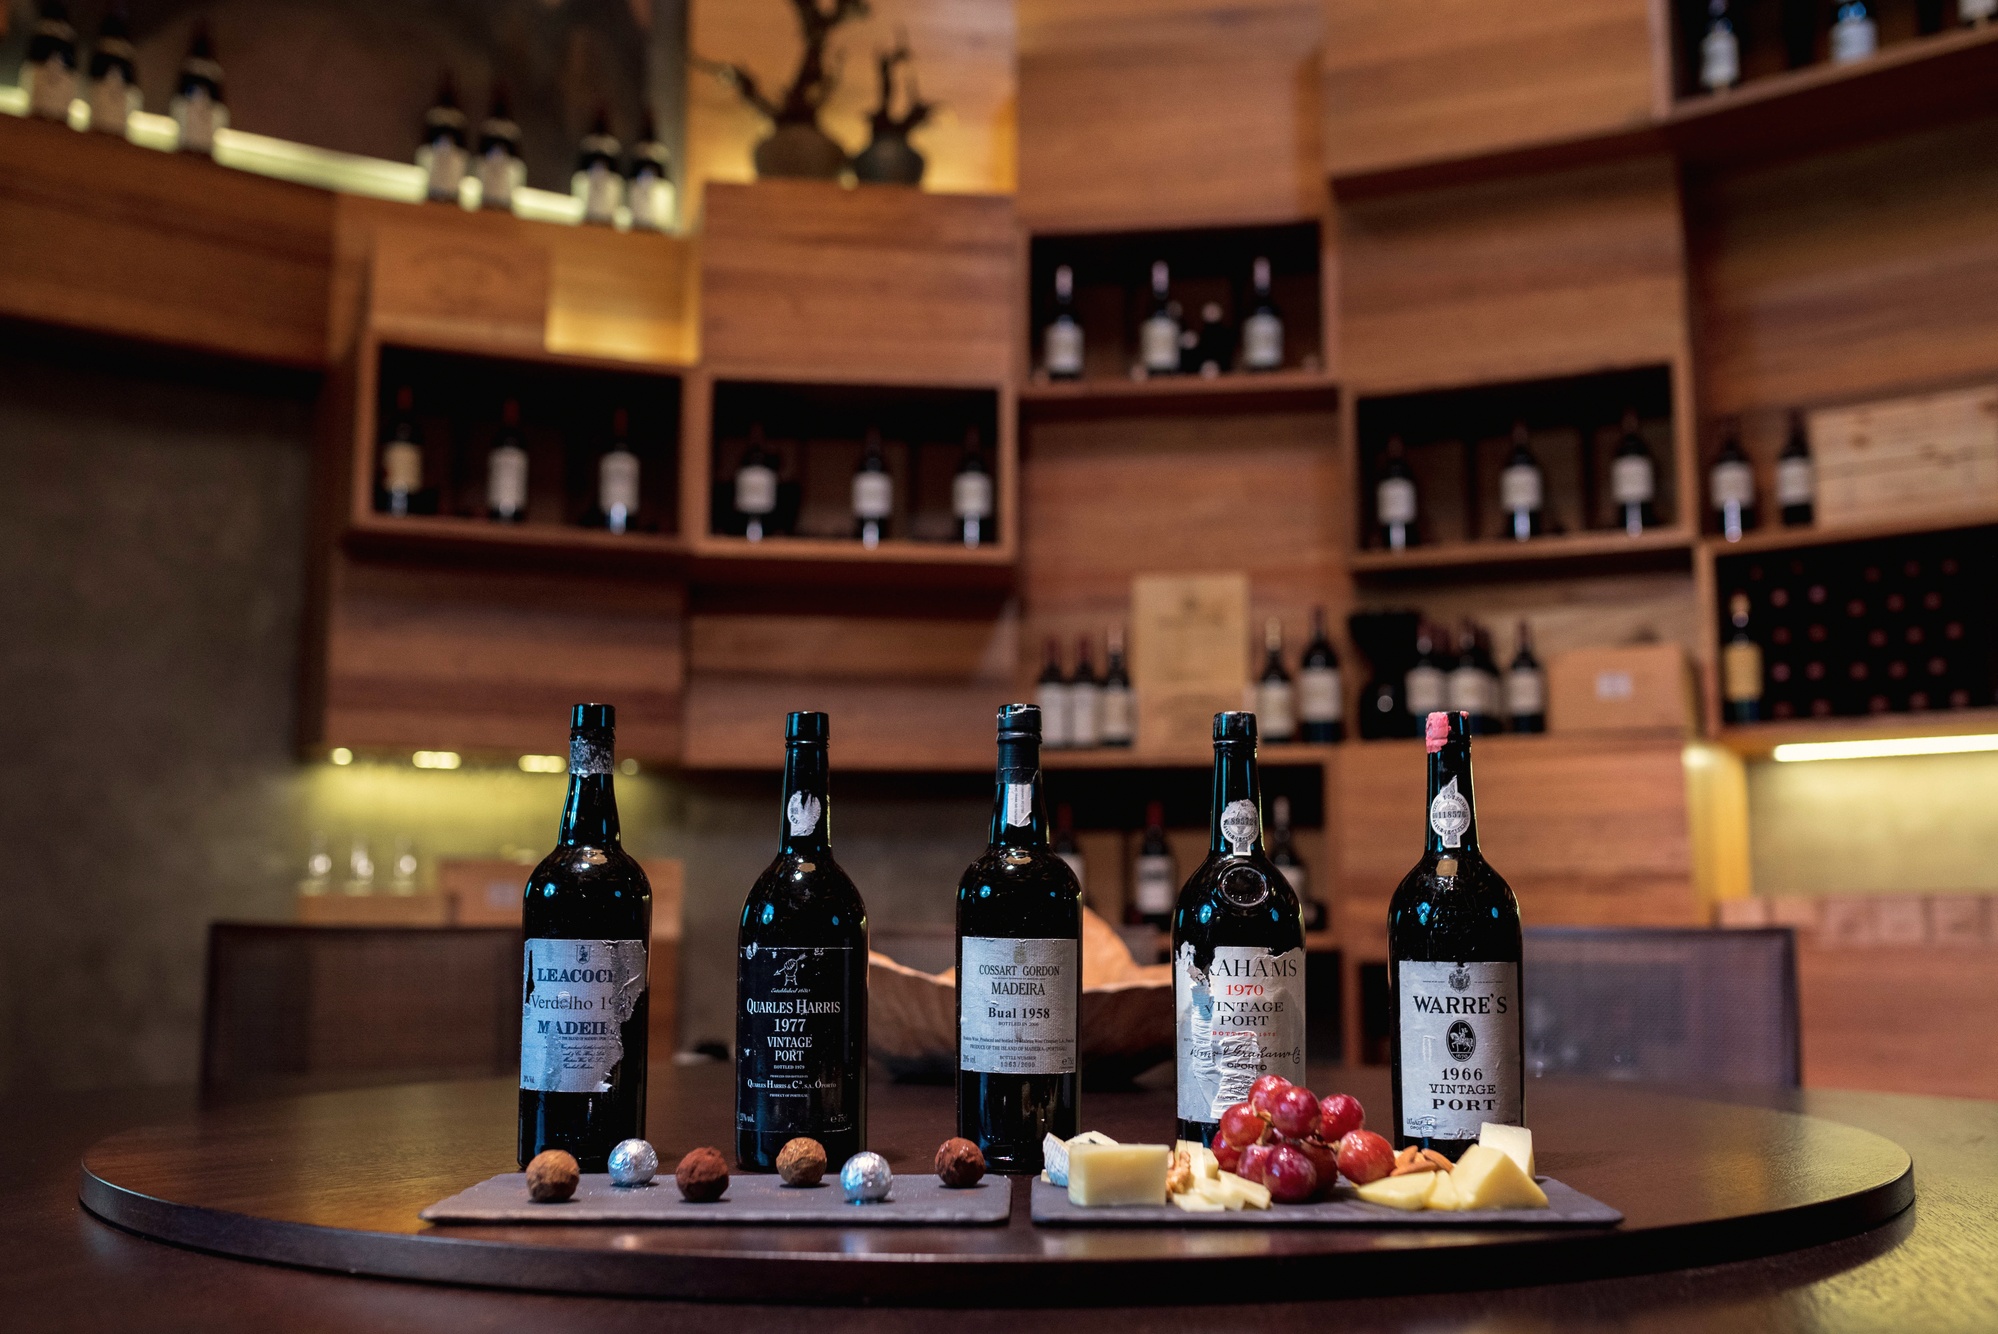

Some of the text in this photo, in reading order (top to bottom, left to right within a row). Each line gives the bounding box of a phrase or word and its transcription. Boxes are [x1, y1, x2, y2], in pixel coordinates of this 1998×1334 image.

[979, 965, 1060, 977] COSSART GORDON
[1209, 958, 1297, 977] AHAMS
[991, 982, 1046, 996] MADEIRA
[1225, 984, 1264, 996] 1970
[746, 997, 841, 1015] QUARLES HARRIS
[1205, 1001, 1284, 1014] VINTAGE
[1412, 993, 1508, 1014] WARRE'S
[988, 1007, 1050, 1019] Bual 1958
[774, 1018, 806, 1032] 1977
[1219, 1015, 1270, 1026] PORT
[767, 1036, 813, 1048] VINTAGE
[774, 1050, 805, 1062] PORT
[1441, 1067, 1484, 1081] 1966
[1429, 1083, 1497, 1095] VINTAGE
[1431, 1098, 1497, 1112] PORT
